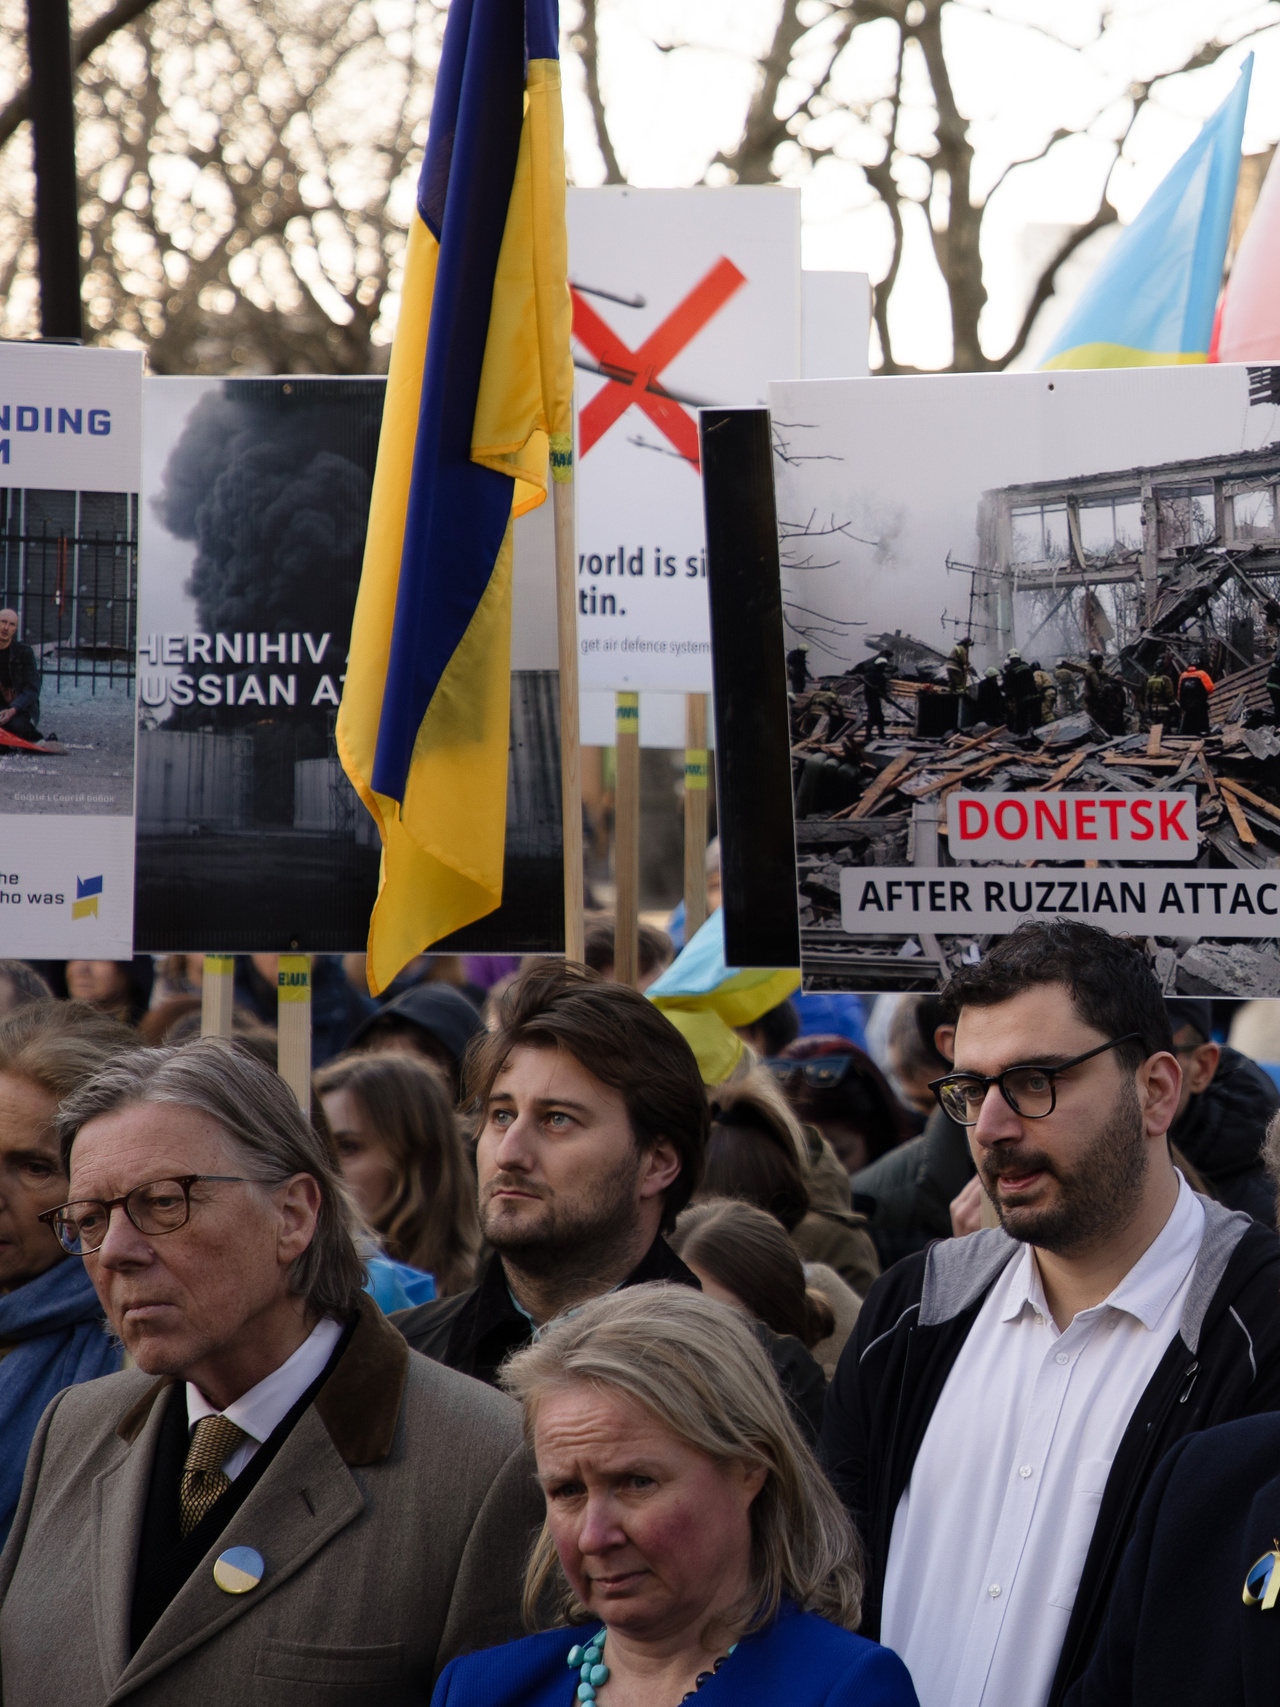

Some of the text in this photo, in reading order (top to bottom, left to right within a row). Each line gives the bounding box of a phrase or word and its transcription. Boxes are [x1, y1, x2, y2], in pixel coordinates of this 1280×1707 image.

[655, 547, 676, 577] is
[579, 586, 626, 616] tin.
[138, 632, 331, 665] HERNIHIV
[580, 638, 600, 656] get
[603, 637, 617, 653] air
[620, 636, 667, 653] defence
[141, 673, 347, 706] USSIAN A
[958, 799, 1190, 842] DONETSK
[27, 893, 65, 904] was
[858, 881, 971, 912] AFTER
[984, 882, 1147, 914] RUZZIAN
